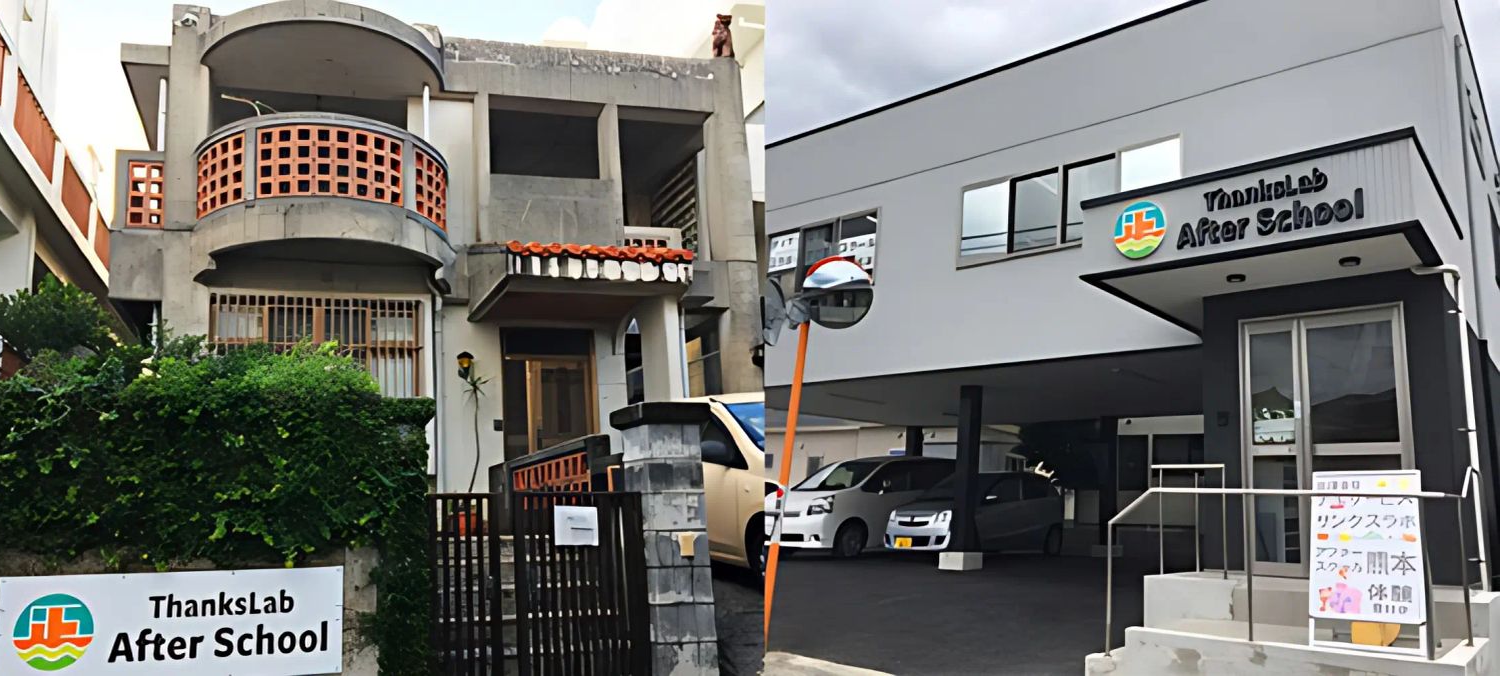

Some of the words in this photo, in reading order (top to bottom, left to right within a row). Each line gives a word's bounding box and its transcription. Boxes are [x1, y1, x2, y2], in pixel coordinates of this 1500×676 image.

[1176, 217, 1251, 251] After
[1256, 187, 1365, 237] School
[148, 589, 295, 619] ThanksLab
[107, 628, 205, 663] After
[213, 620, 329, 658] School
